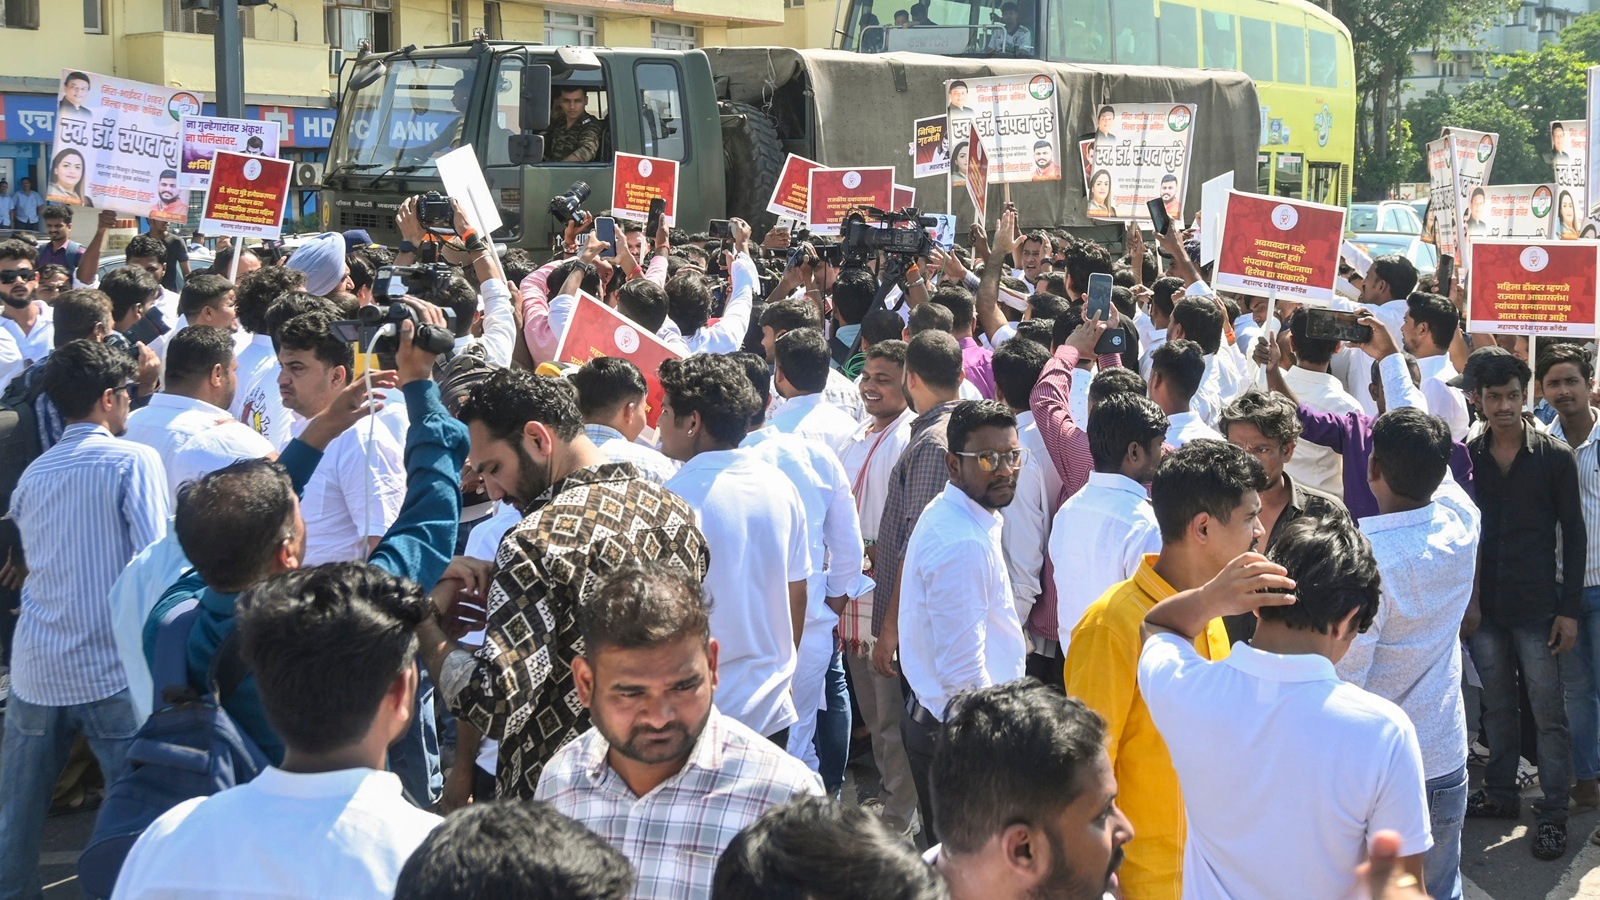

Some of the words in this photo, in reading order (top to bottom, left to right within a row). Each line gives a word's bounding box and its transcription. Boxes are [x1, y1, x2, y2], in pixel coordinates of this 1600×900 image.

[908, 34, 948, 48] SWITCH
[101, 98, 122, 110] जिल्हा
[122, 102, 139, 114] युवक
[186, 120, 196, 129] ना
[198, 120, 239, 132] गुन्हेगारांवर
[241, 123, 264, 136] अंकुश.
[392, 120, 440, 140] ANK
[976, 112, 994, 137] डॉ.
[996, 111, 1030, 136] संपदा
[1030, 107, 1054, 139] मुंडे
[61, 118, 88, 146] स्व.
[92, 118, 115, 150] डॉ.
[118, 124, 164, 158] संपदा
[185, 134, 195, 142] ना
[198, 133, 237, 146] पोलिसांवर.
[1096, 144, 1112, 166] स्व.
[1116, 140, 1131, 166] डॉ.
[1133, 141, 1164, 166] संपदा
[1164, 140, 1185, 173] मुंडे
[1556, 164, 1571, 186] स्व.
[1254, 238, 1290, 251] अवयवदान
[1291, 243, 1306, 255] नव्हे,
[1257, 249, 1286, 260] न्यायदान
[1243, 256, 1273, 268] संपदाच्या
[1274, 261, 1313, 275] बलिदानाचा
[1245, 266, 1265, 277] हिशेब
[1276, 272, 1308, 284] सरकारने!
[1242, 279, 1262, 288] महाराष्ट्र
[1263, 282, 1275, 290] प्रदेश
[1276, 284, 1290, 292] युवक
[1497, 282, 1521, 291] महिला
[1522, 282, 1545, 291] डॉक्टर
[1546, 283, 1570, 292] म्हणजे
[1527, 293, 1568, 301] आधारस्तंभ!
[1495, 302, 1519, 310] त्यांच्या
[1520, 303, 1556, 311] सन्मानाचा
[1558, 304, 1571, 312] प्रश्न
[1549, 313, 1567, 322] आहे!
